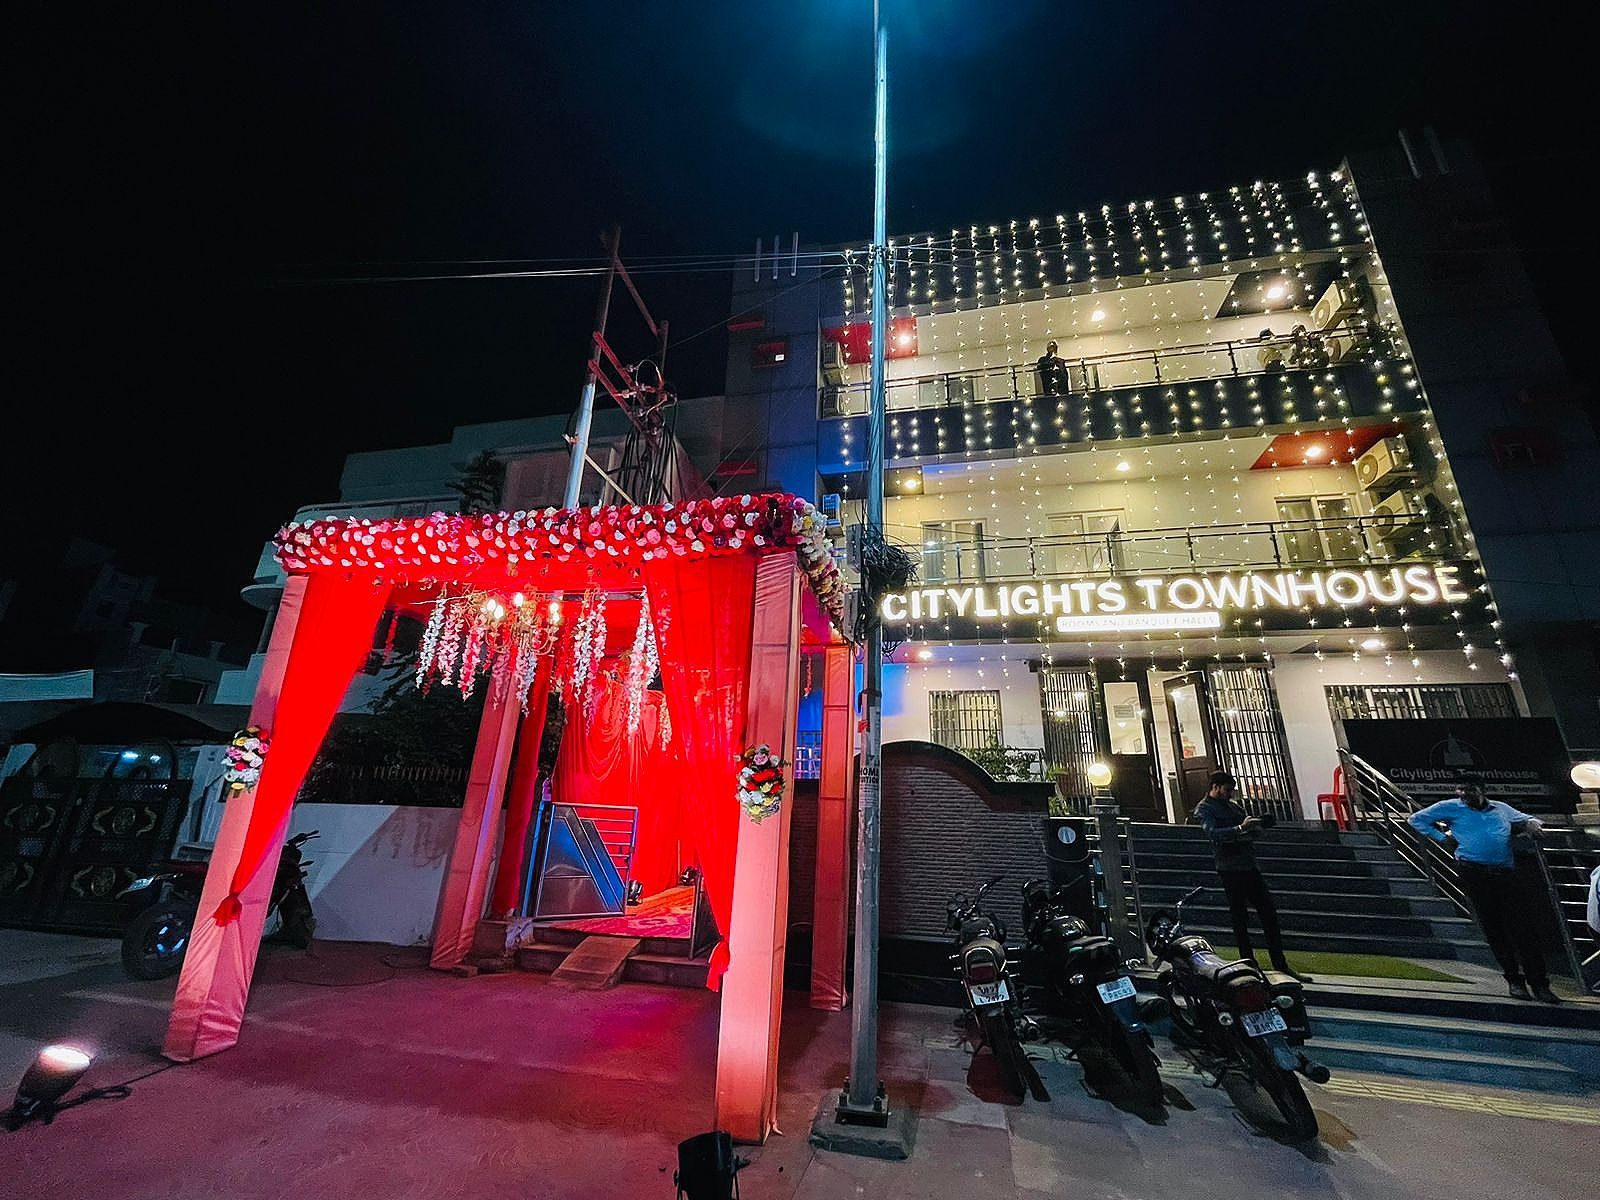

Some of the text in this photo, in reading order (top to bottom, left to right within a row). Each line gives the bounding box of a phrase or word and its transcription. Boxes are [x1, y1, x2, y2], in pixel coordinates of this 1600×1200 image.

[882, 565, 1468, 620] CITYLIGHTS TOWNHOUSE
[1390, 768, 1454, 780] Citylights
